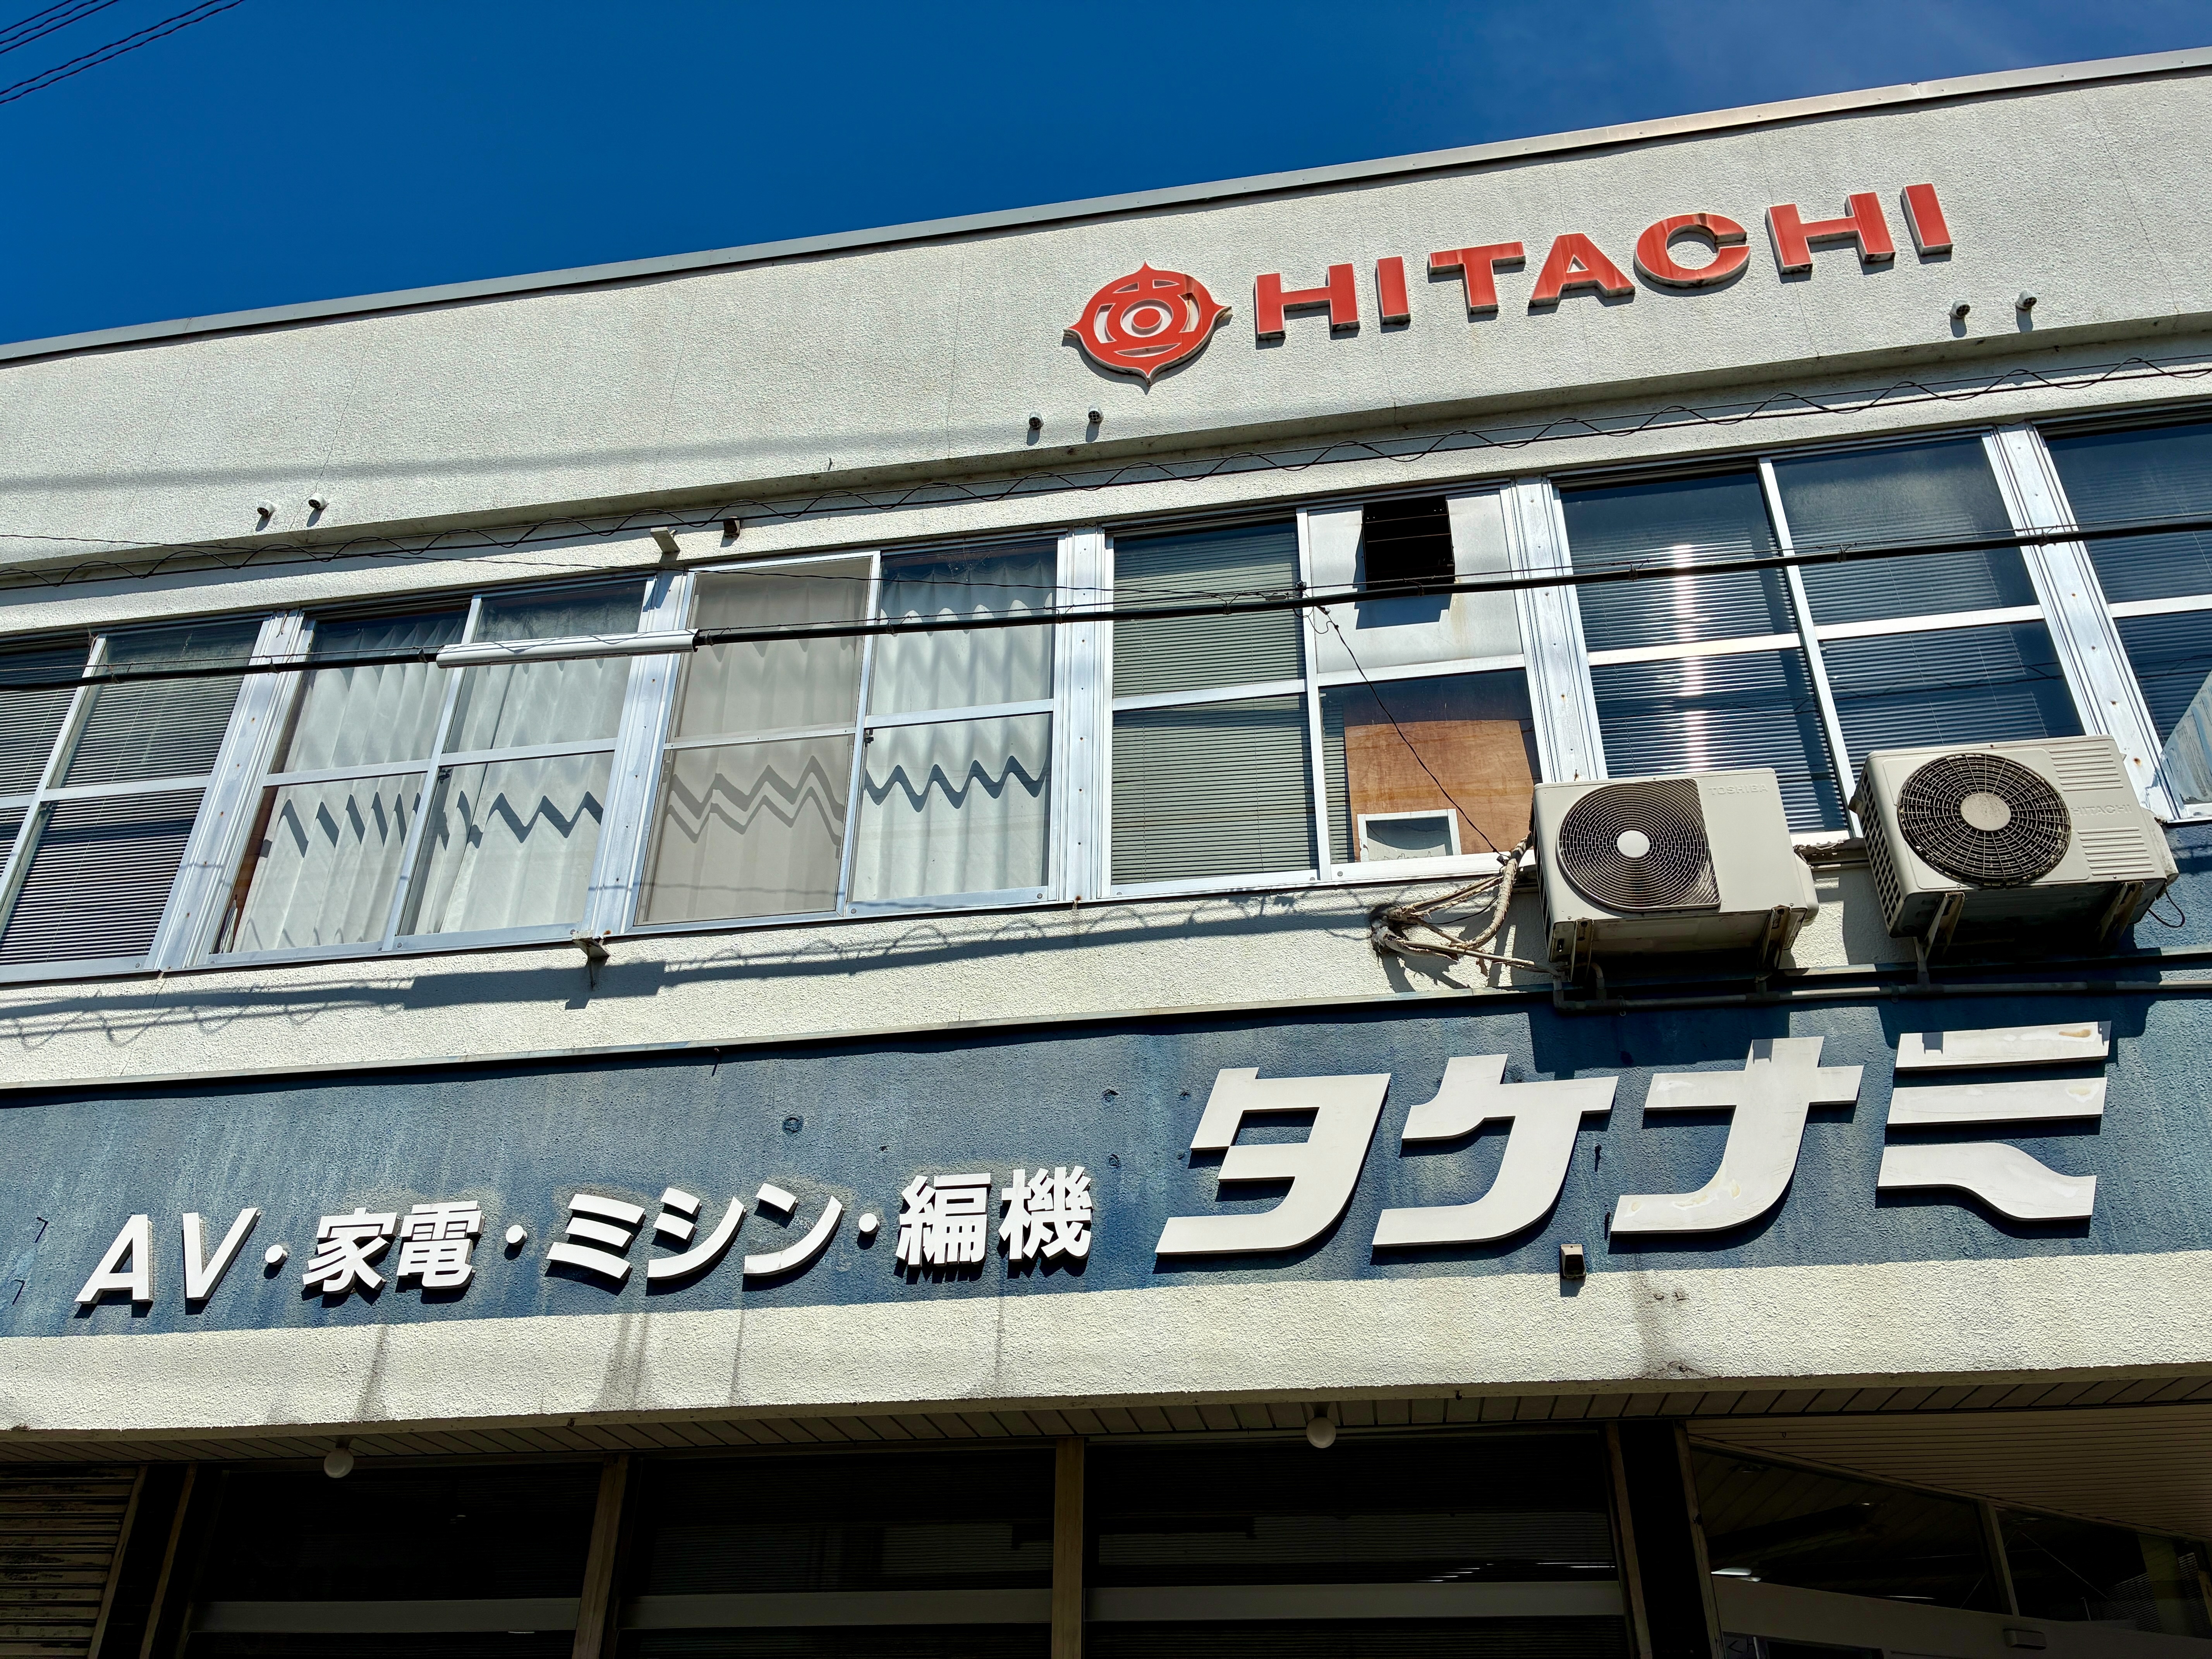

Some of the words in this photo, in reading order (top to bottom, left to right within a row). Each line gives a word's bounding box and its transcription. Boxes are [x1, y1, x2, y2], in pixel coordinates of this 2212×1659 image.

[1254, 183, 1953, 339] HITACHI
[1708, 784, 1768, 795] TOSHIBA
[2070, 804, 2132, 816] HITACHI
[1156, 1022, 2111, 1255] タケナミ
